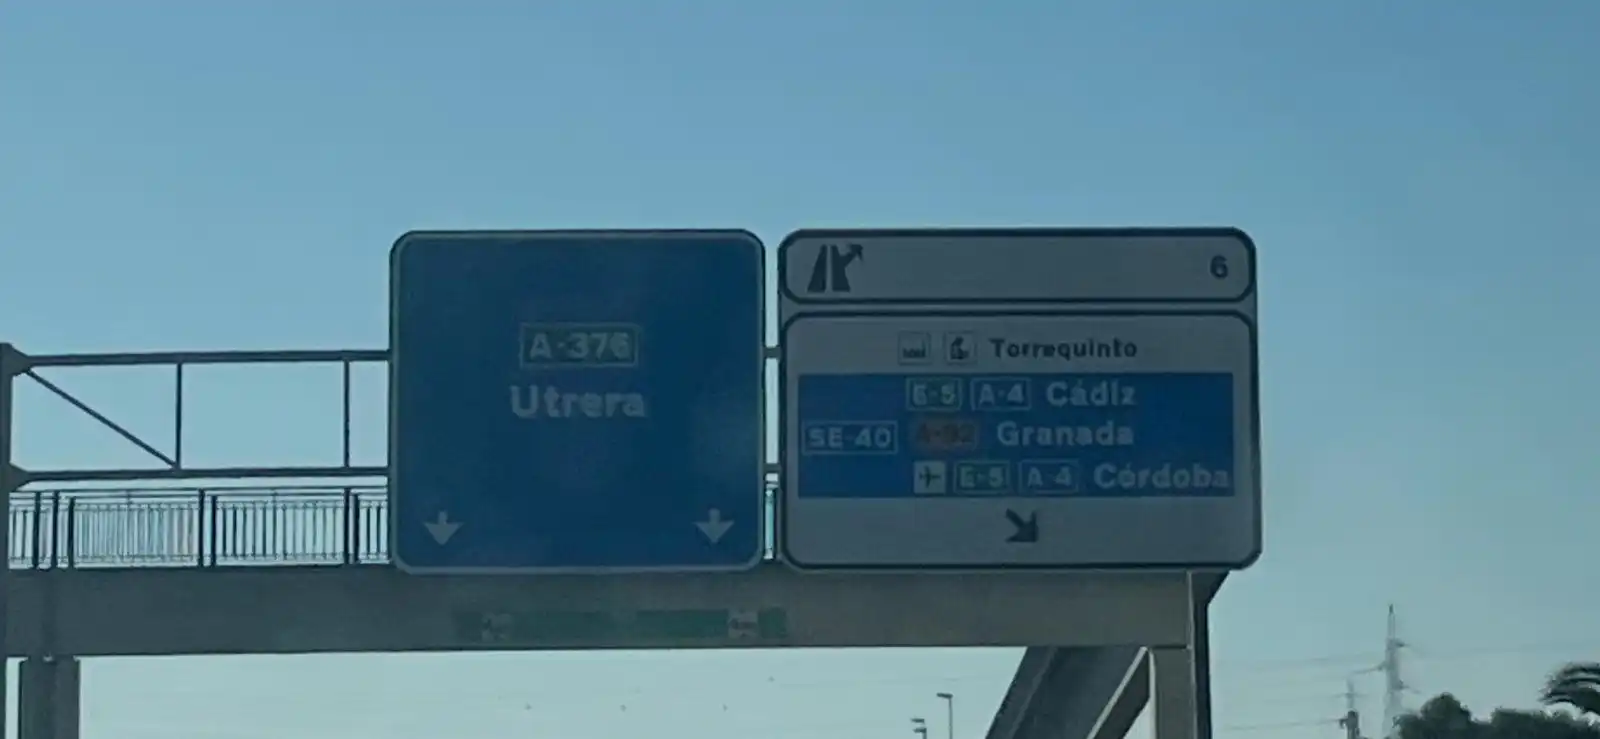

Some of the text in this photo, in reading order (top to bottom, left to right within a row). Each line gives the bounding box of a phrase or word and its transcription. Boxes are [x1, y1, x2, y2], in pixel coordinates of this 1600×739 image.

[1210, 255, 1229, 279] 6
[529, 332, 632, 359] A-376
[989, 338, 1138, 362] Torrequinto
[509, 383, 648, 418] Utrera
[911, 381, 956, 405] E-5
[978, 381, 1025, 405] A-4
[1045, 379, 1136, 407] Cádiz
[808, 426, 892, 449] SE-40
[996, 421, 1135, 447] Granada
[959, 465, 1005, 488] E-5
[1027, 465, 1073, 487] A-4
[1093, 460, 1230, 489] Córdoba
